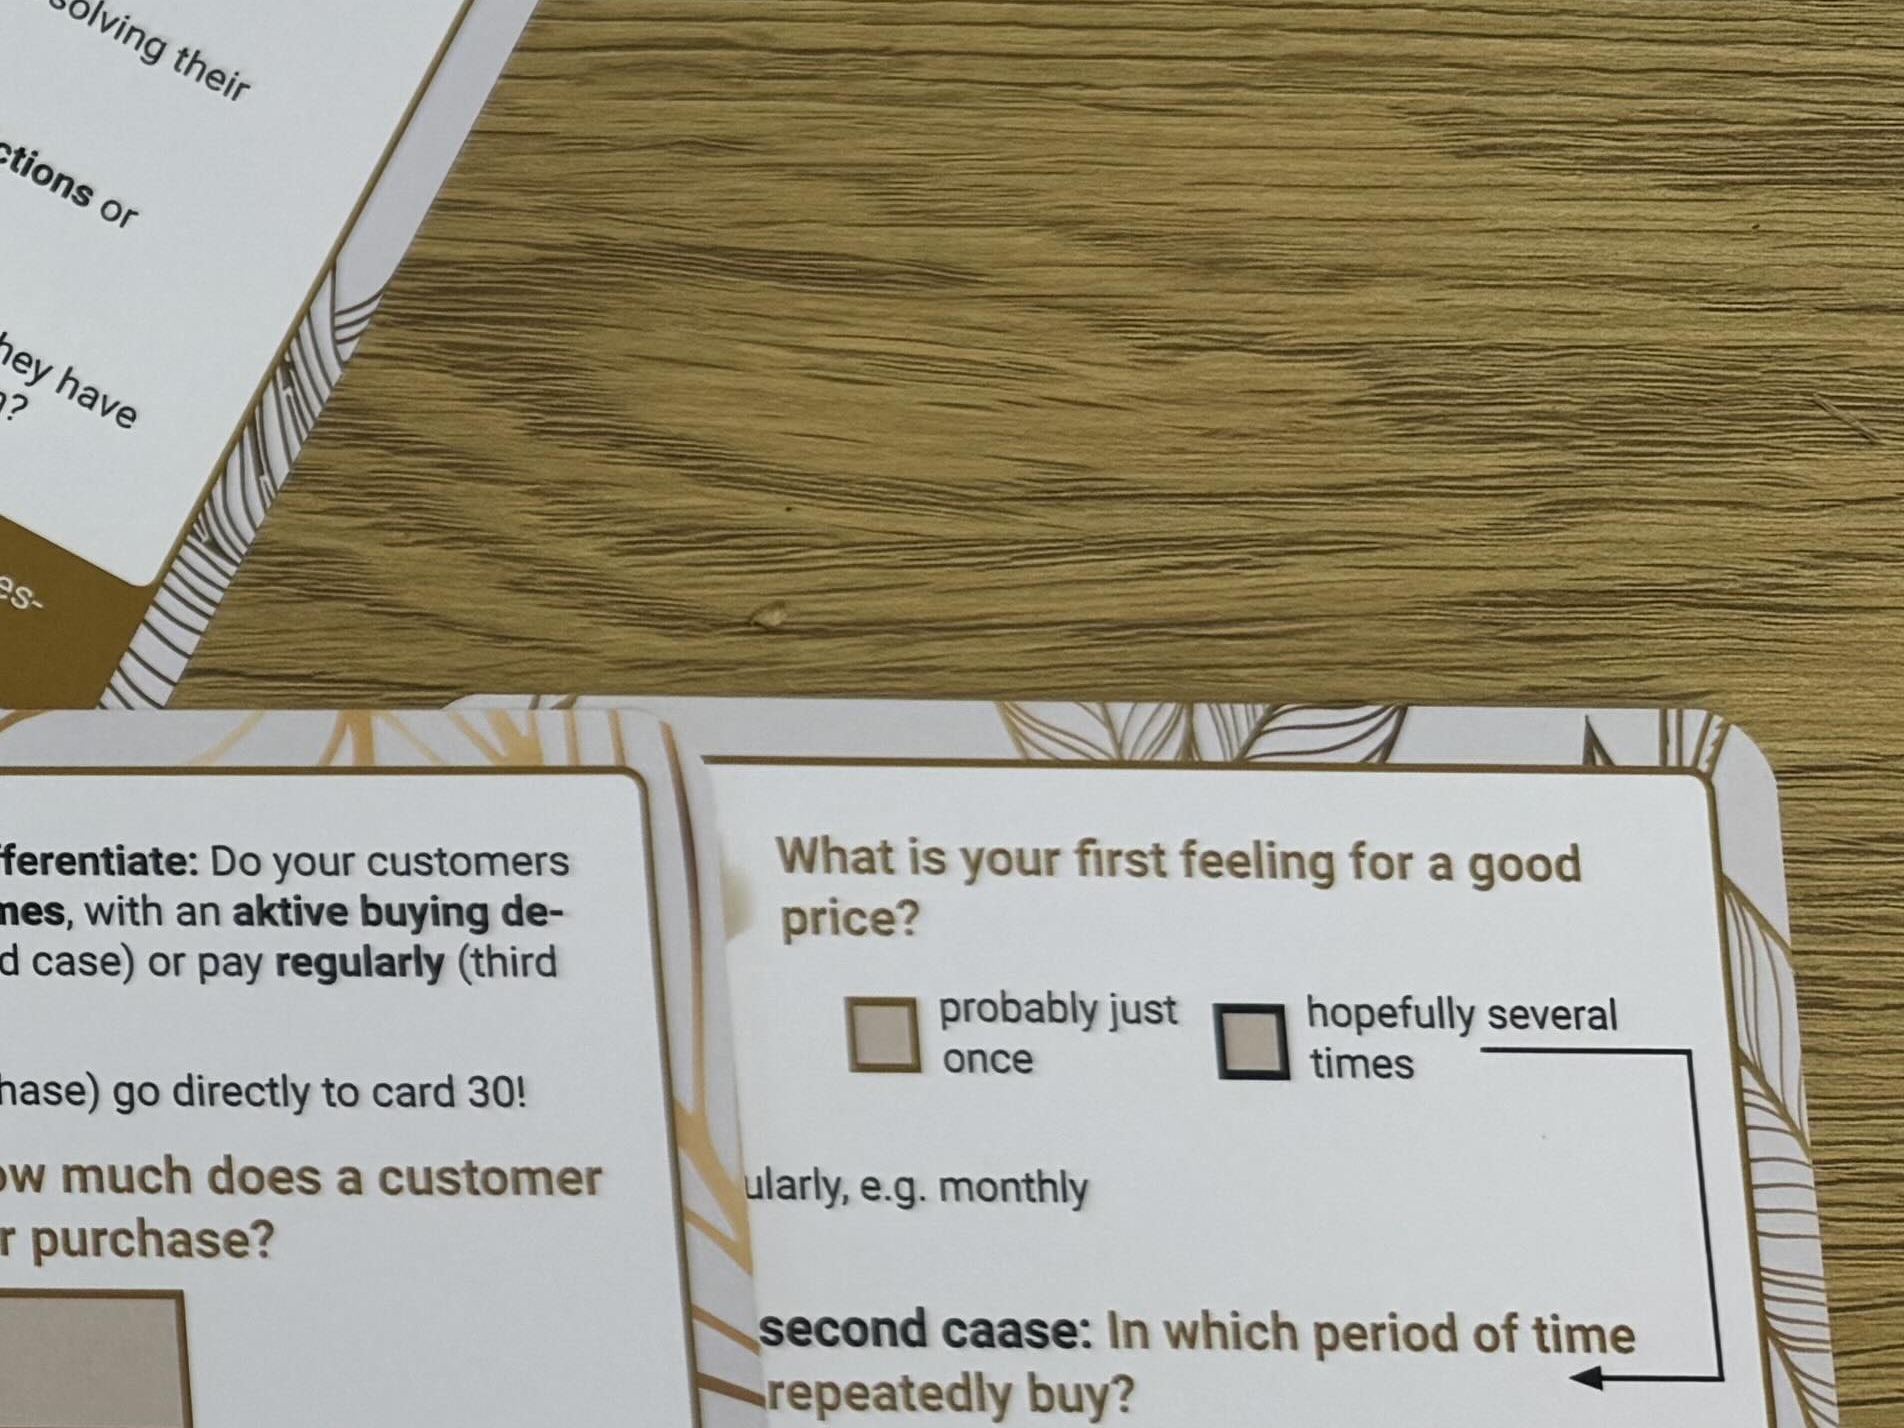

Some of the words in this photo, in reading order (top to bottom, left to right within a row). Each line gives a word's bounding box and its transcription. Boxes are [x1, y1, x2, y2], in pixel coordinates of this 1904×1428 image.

[100, 199, 140, 229] or
[211, 844, 262, 877] Do
[272, 851, 356, 885] your
[367, 847, 570, 877] customers
[775, 834, 896, 876] What
[908, 836, 948, 876] is
[959, 847, 1062, 887] your
[1073, 837, 1168, 879] first
[1179, 838, 1336, 890] feeling
[1348, 840, 1414, 881] for
[1428, 852, 1454, 882] a
[1468, 842, 1582, 892] good
[781, 896, 921, 946] price?
[939, 989, 1099, 1033] probably
[1108, 995, 1179, 1033] just
[1307, 993, 1476, 1038] hopefully
[1488, 997, 1618, 1031] several
[943, 1048, 1034, 1075] once
[1309, 1048, 1415, 1080] times
